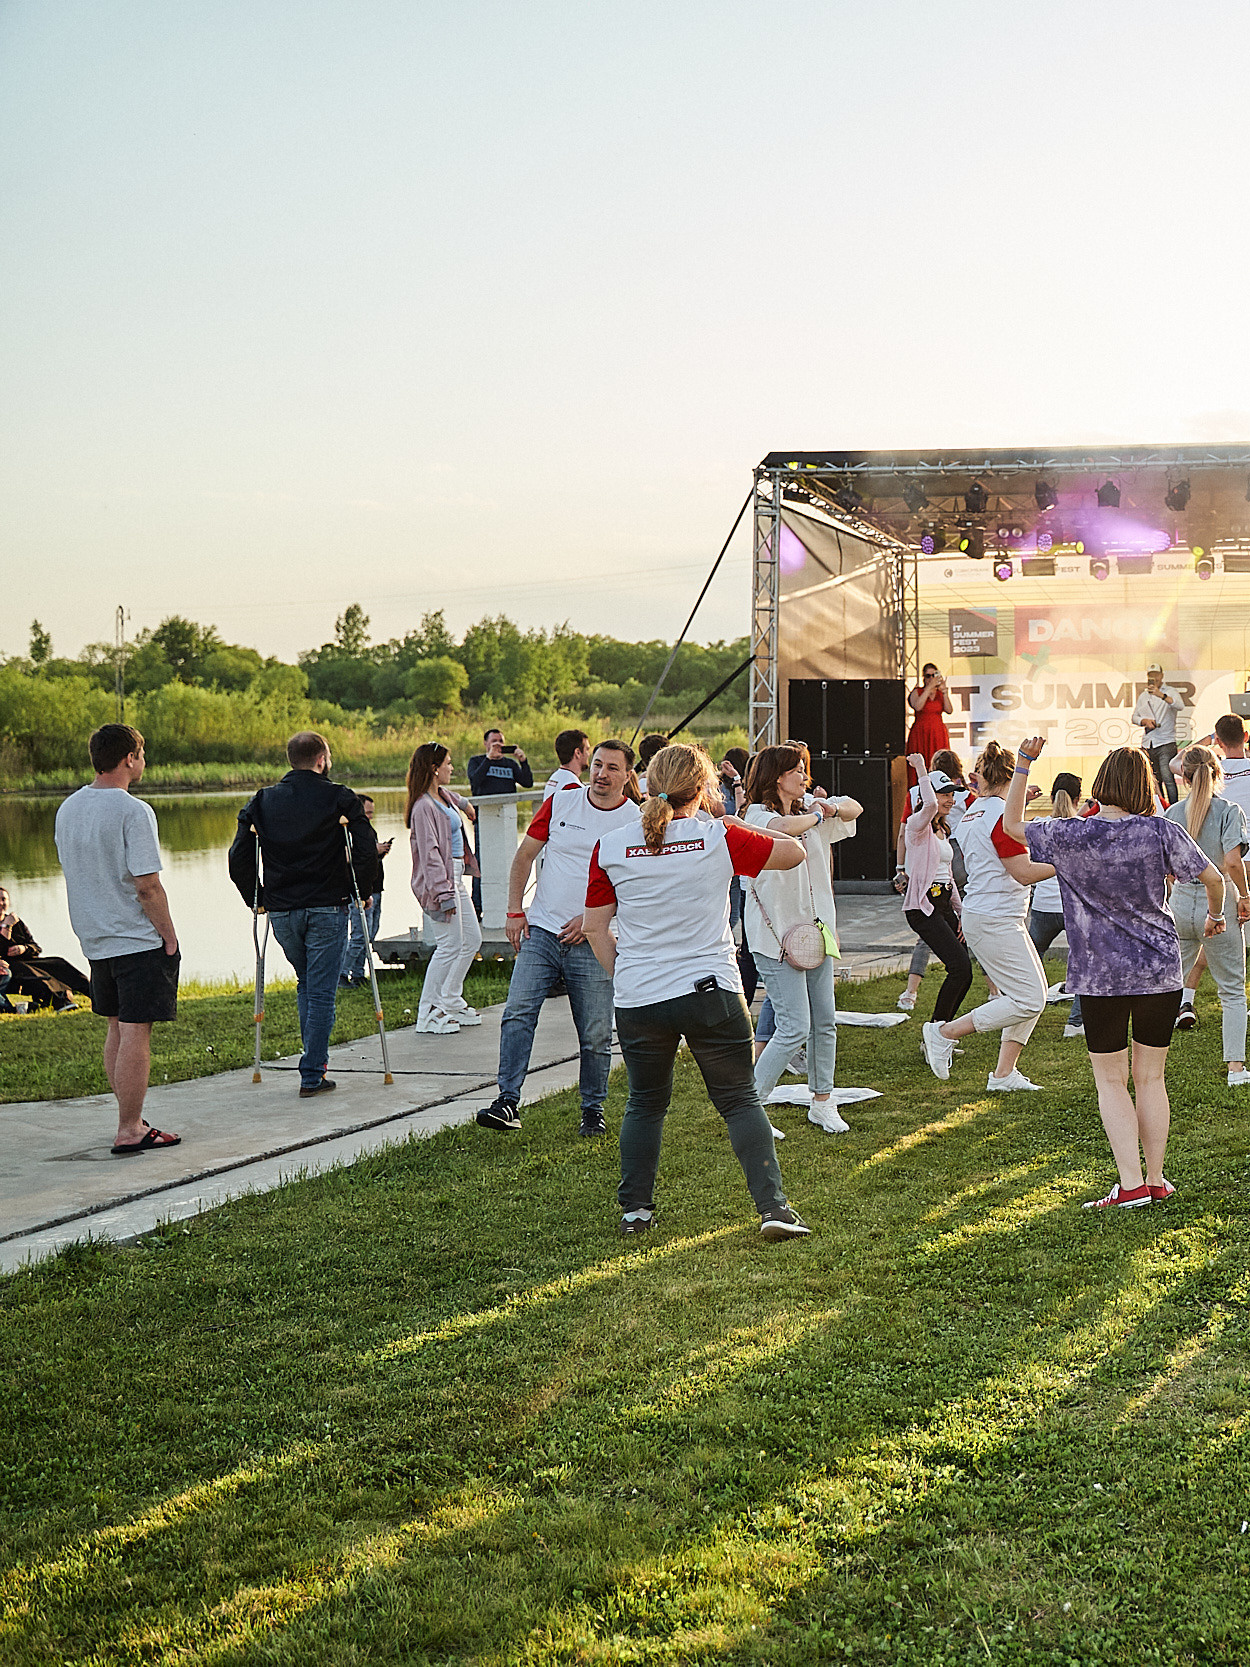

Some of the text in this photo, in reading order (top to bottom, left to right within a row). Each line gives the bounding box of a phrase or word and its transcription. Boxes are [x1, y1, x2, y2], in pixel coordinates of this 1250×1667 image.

[952, 624, 962, 632] IT
[952, 631, 995, 639] SUMMER
[952, 638, 979, 646] FEST
[953, 645, 980, 653] 2023
[628, 841, 703, 857] ХАБРОВСК
